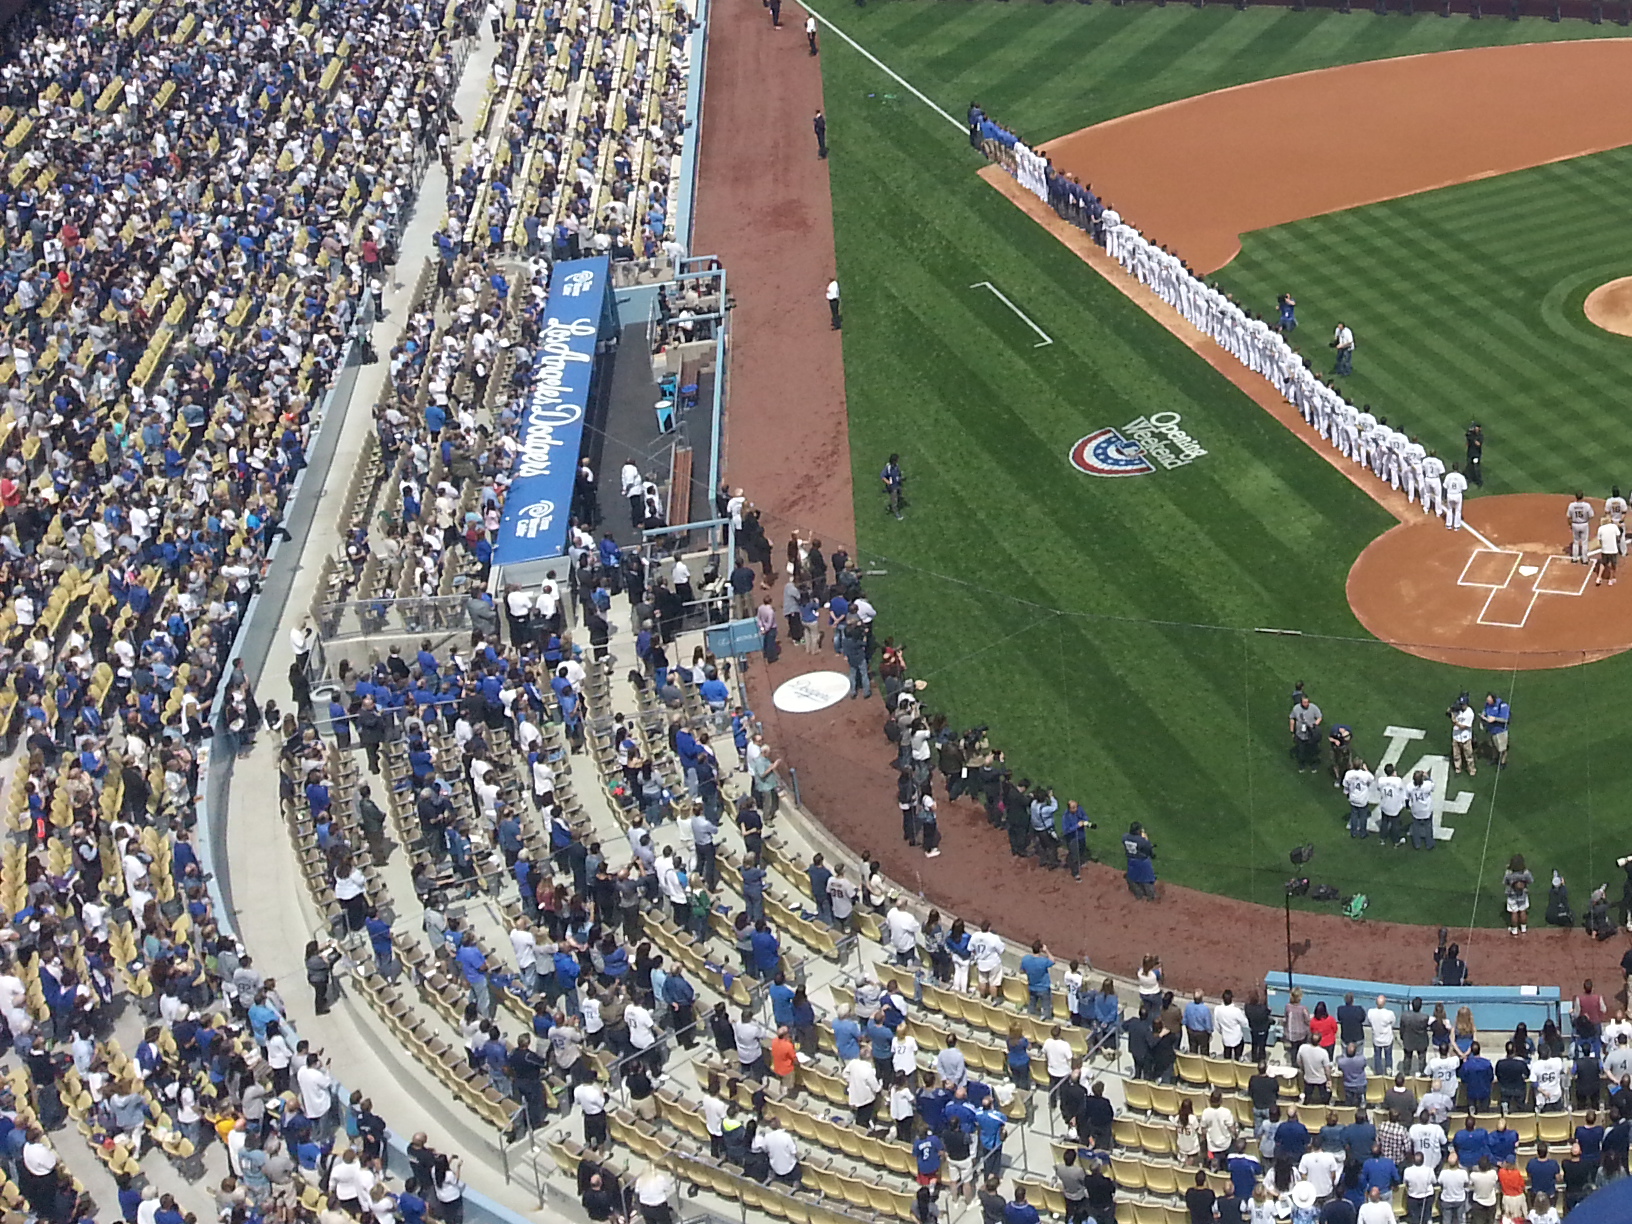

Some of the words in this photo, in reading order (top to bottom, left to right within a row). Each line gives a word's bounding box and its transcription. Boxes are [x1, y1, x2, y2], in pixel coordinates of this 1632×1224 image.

[532, 342, 591, 404] Angeles
[520, 403, 582, 477] Dodgers
[1122, 415, 1192, 470] Weekend
[1150, 412, 1208, 460] Opening
